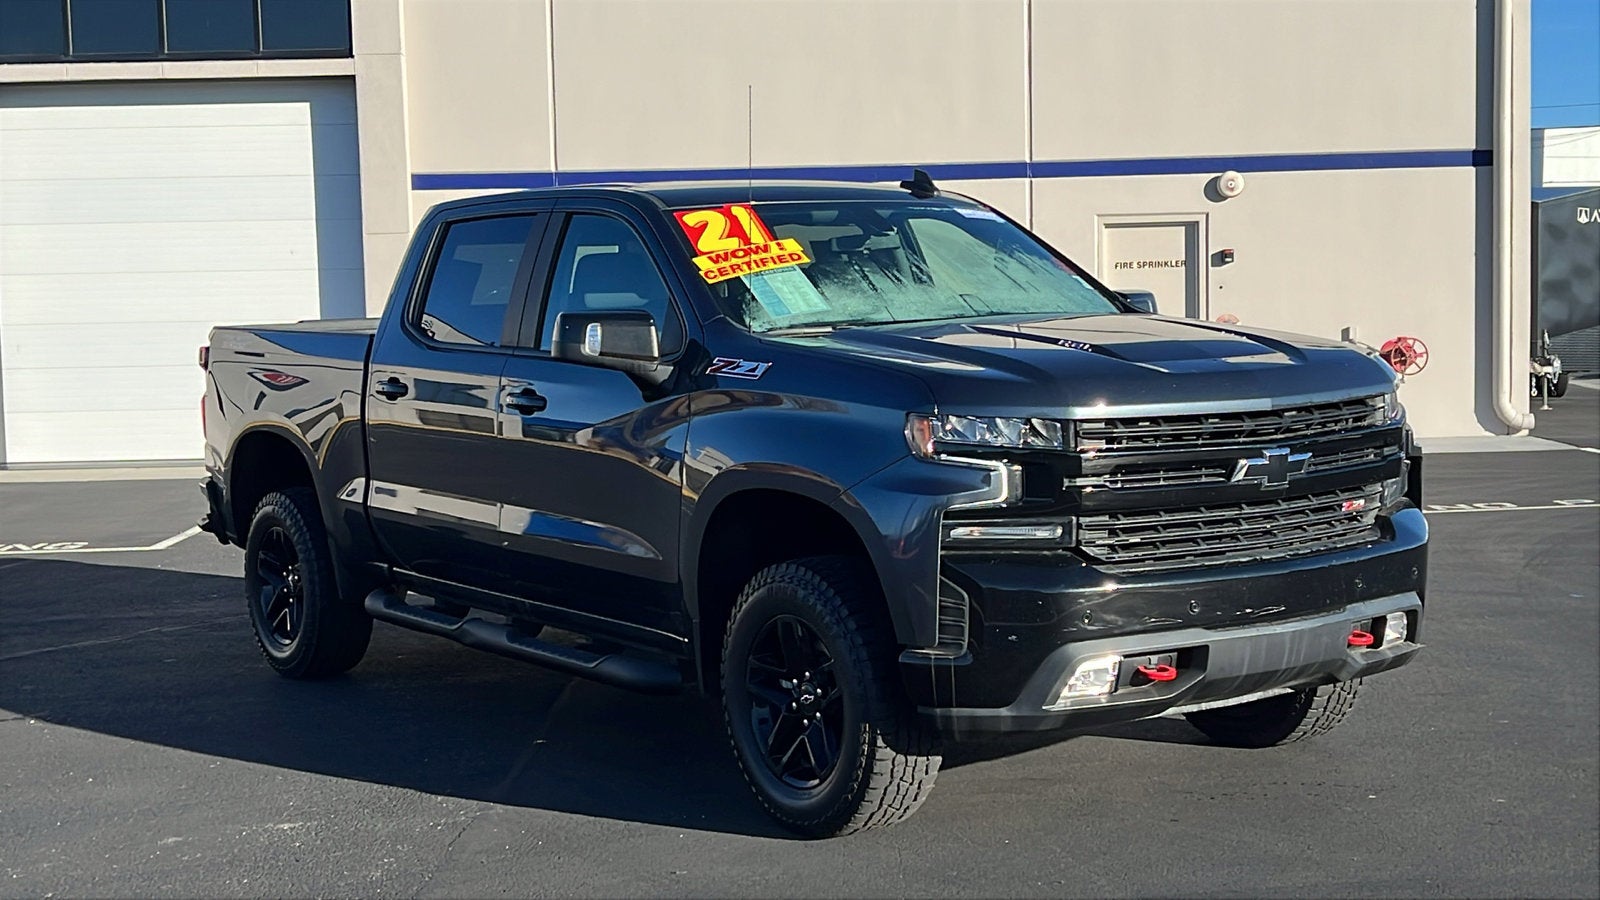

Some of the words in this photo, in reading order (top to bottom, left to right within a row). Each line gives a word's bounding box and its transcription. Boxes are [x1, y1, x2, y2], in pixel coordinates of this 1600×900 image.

[682, 206, 766, 252] 21
[703, 252, 802, 280] CERTIFIED
[1114, 261, 1134, 269] FIRE
[1137, 260, 1187, 269] SPRINKLER
[705, 357, 773, 379] Z71
